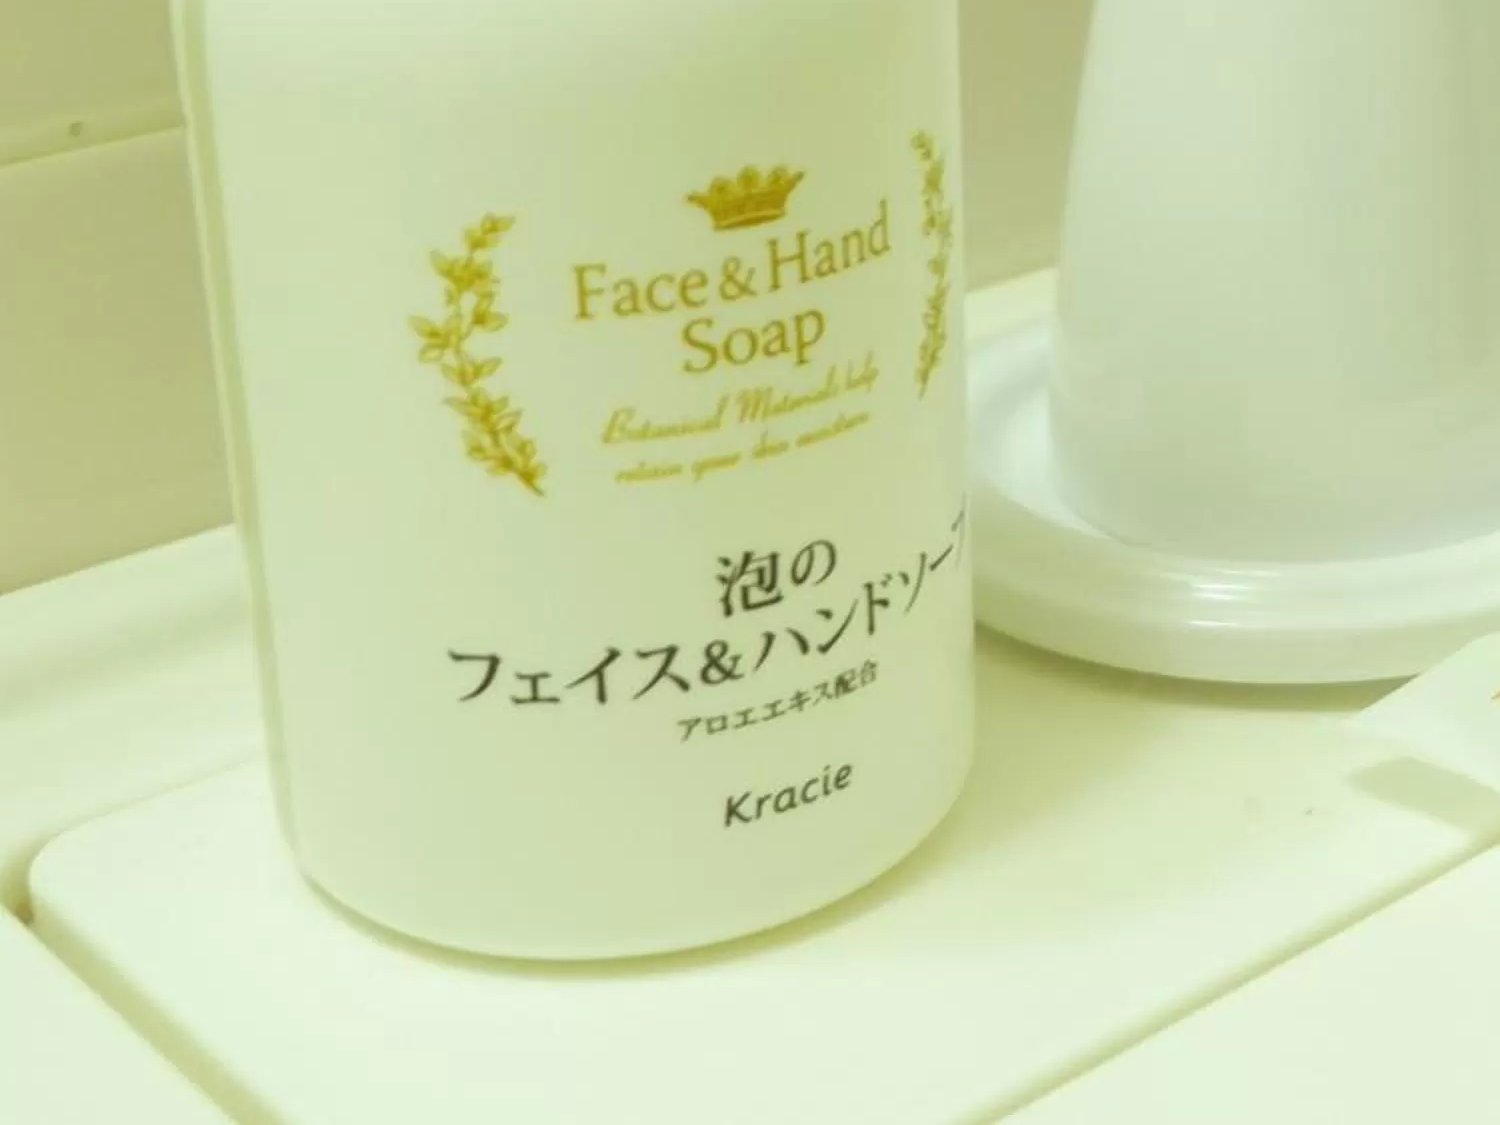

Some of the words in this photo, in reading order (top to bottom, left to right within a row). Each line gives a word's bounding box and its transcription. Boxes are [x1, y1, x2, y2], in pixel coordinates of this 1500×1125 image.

[573, 262, 710, 320] Face
[718, 256, 757, 302] &
[766, 197, 891, 292] Hand
[681, 305, 826, 374] Soap
[716, 539, 837, 618] 泡の
[675, 658, 878, 743] アロエエキス配合
[723, 764, 853, 828] Kracie
